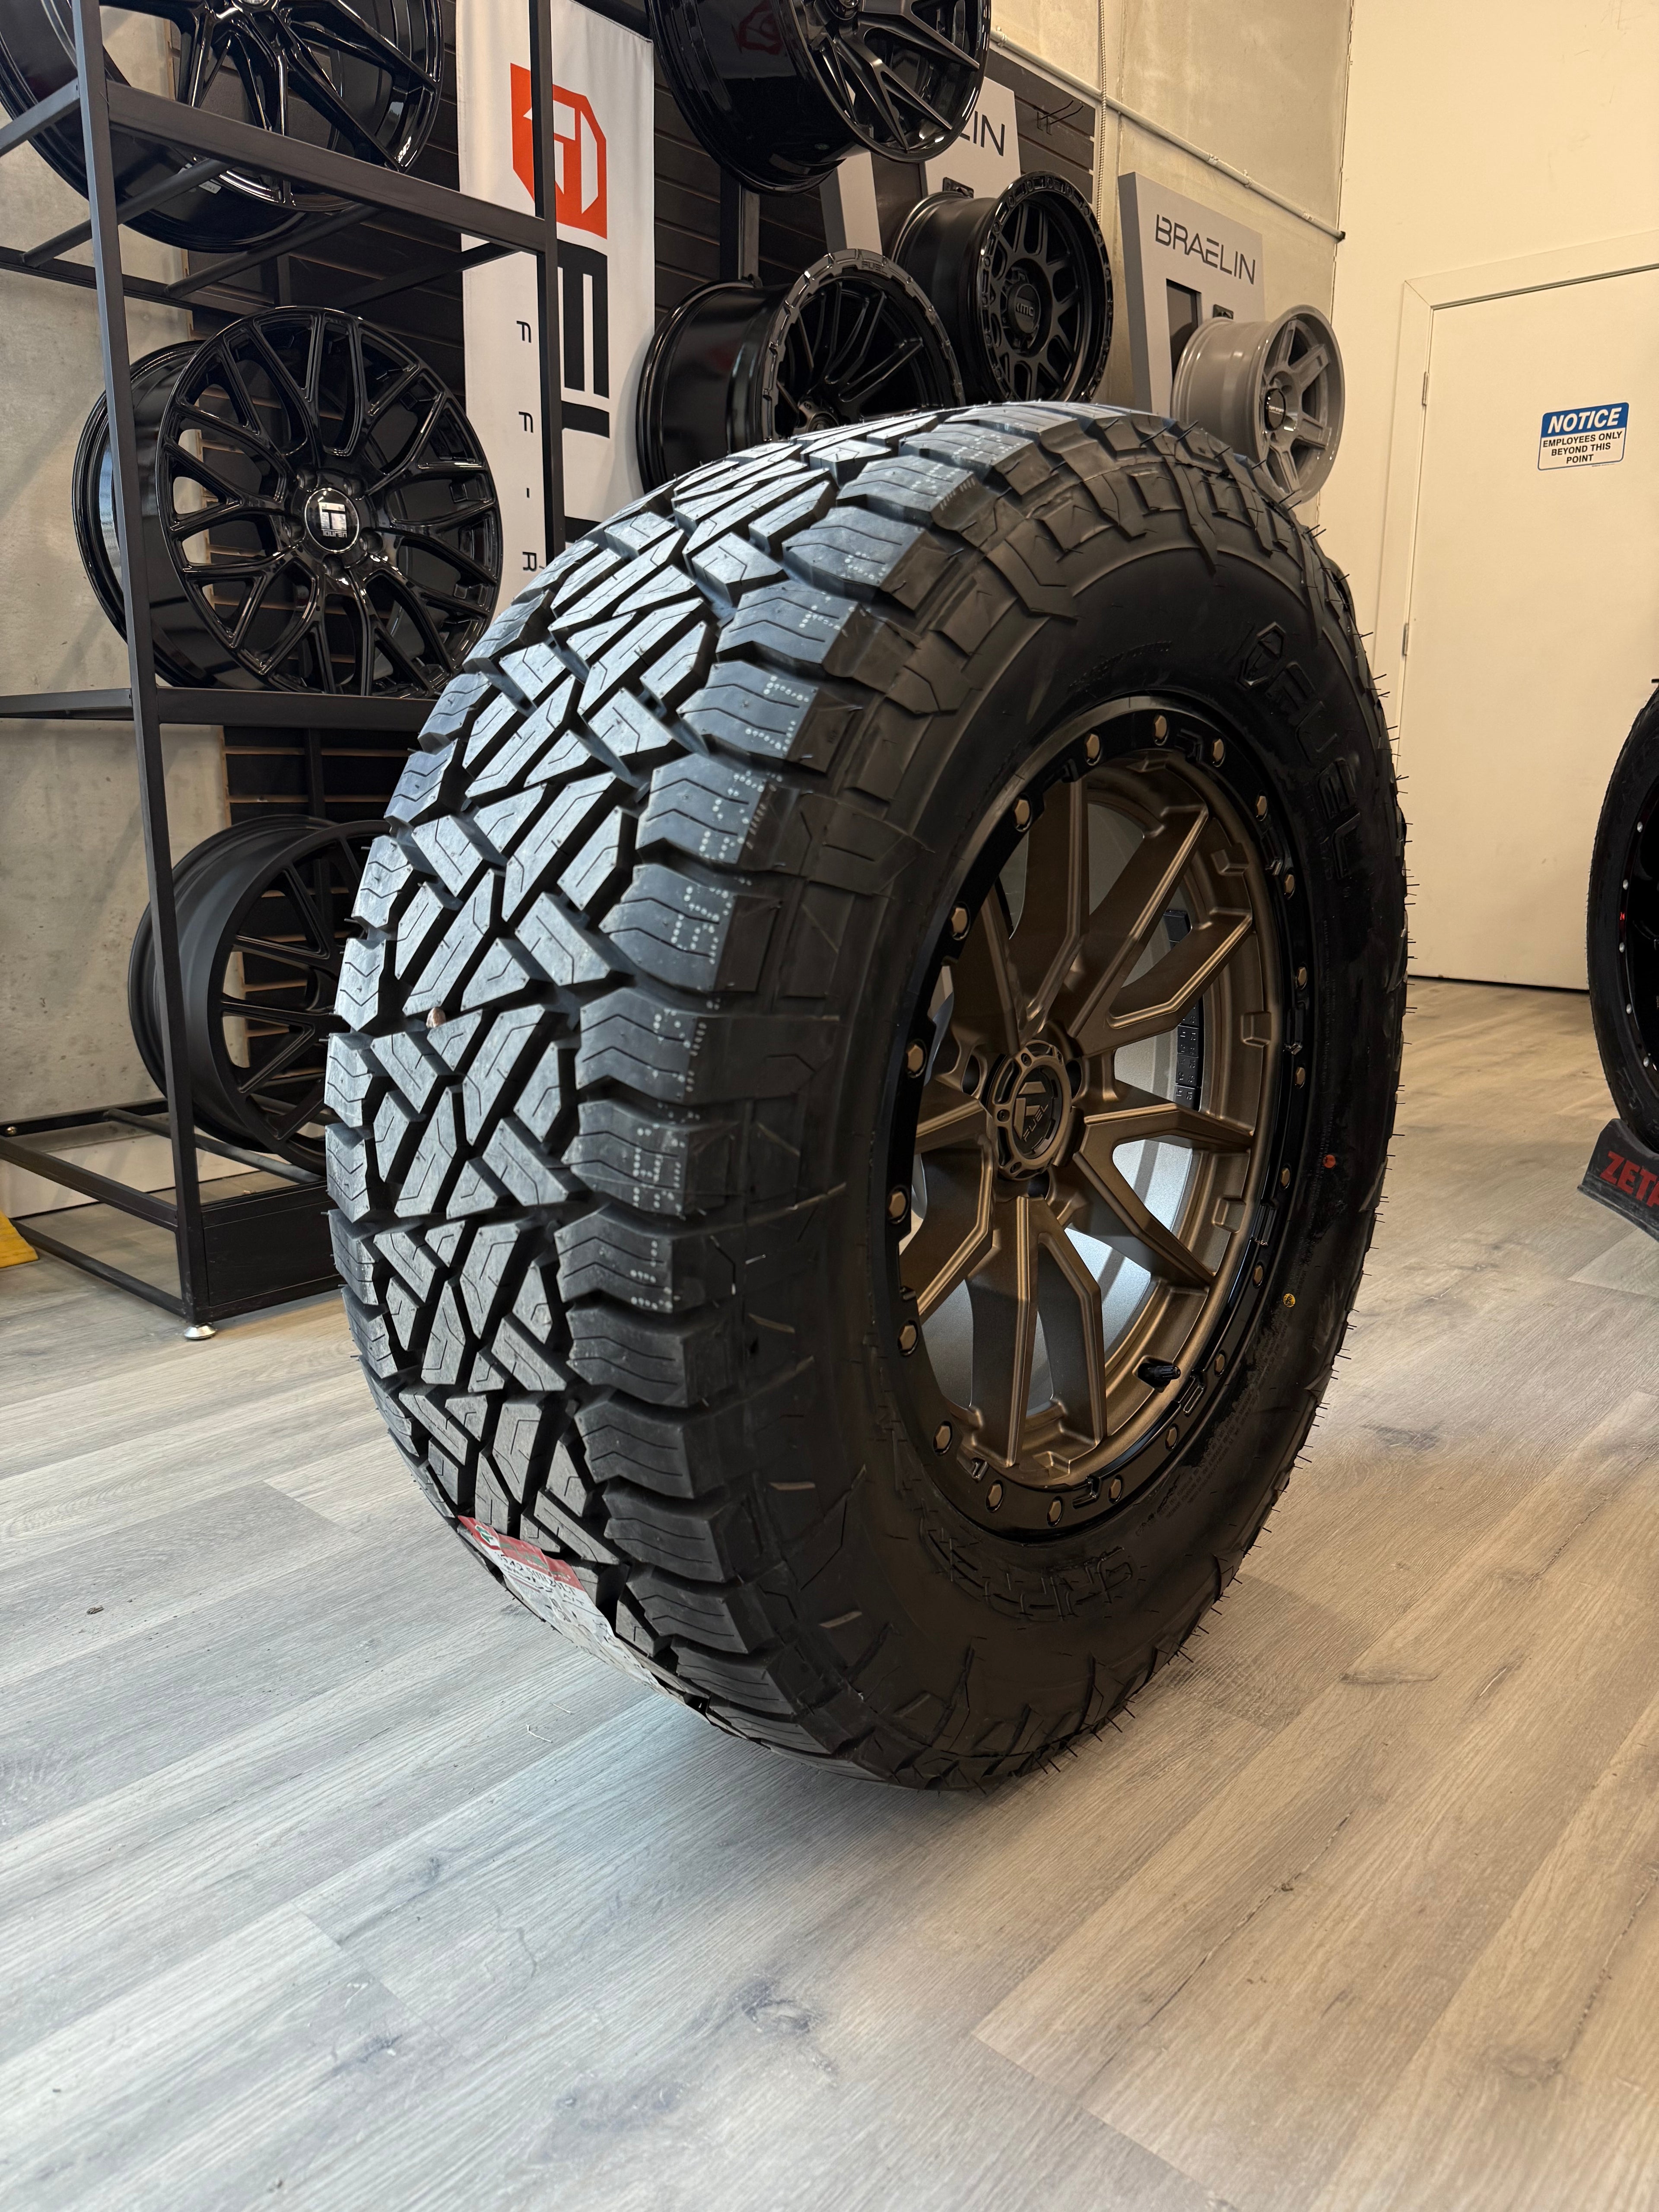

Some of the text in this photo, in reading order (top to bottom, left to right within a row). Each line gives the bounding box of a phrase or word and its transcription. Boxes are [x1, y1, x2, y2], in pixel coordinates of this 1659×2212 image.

[960, 111, 1005, 157] IN
[1155, 214, 1256, 285] BRAELIN
[1548, 407, 1622, 434] NOTICE
[1543, 431, 1622, 448] EMPLOYEES ONLY
[1551, 442, 1611, 456] BEYOND THIS
[1566, 454, 1594, 464] POINT
[1022, 1104, 1049, 1142] FUEL
